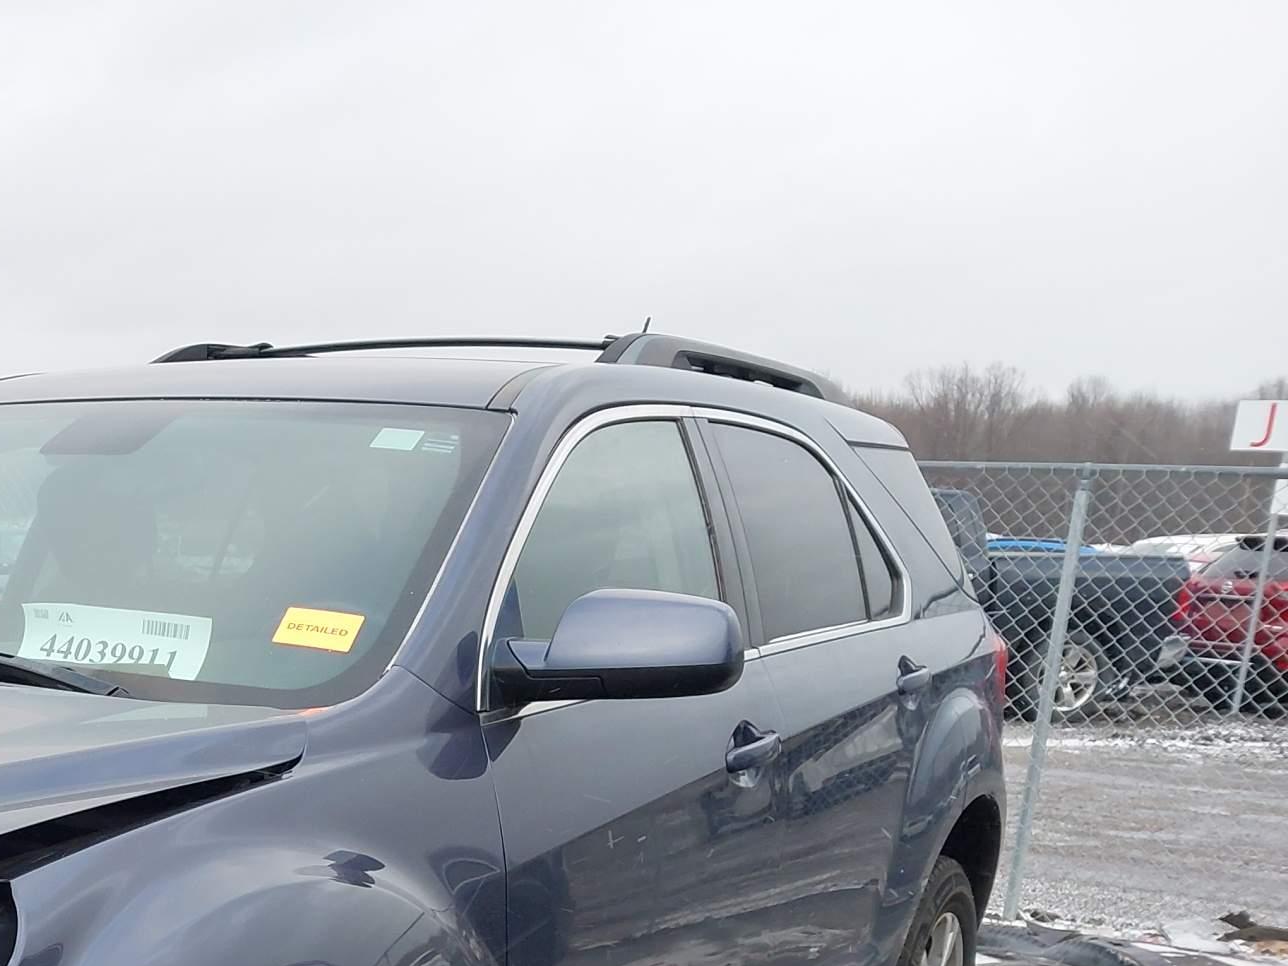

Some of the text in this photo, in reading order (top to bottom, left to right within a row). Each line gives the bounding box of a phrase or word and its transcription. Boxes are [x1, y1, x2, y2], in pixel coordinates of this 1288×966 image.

[1249, 402, 1278, 448] J
[286, 622, 349, 637] DETAILED
[39, 632, 178, 672] 44039911
